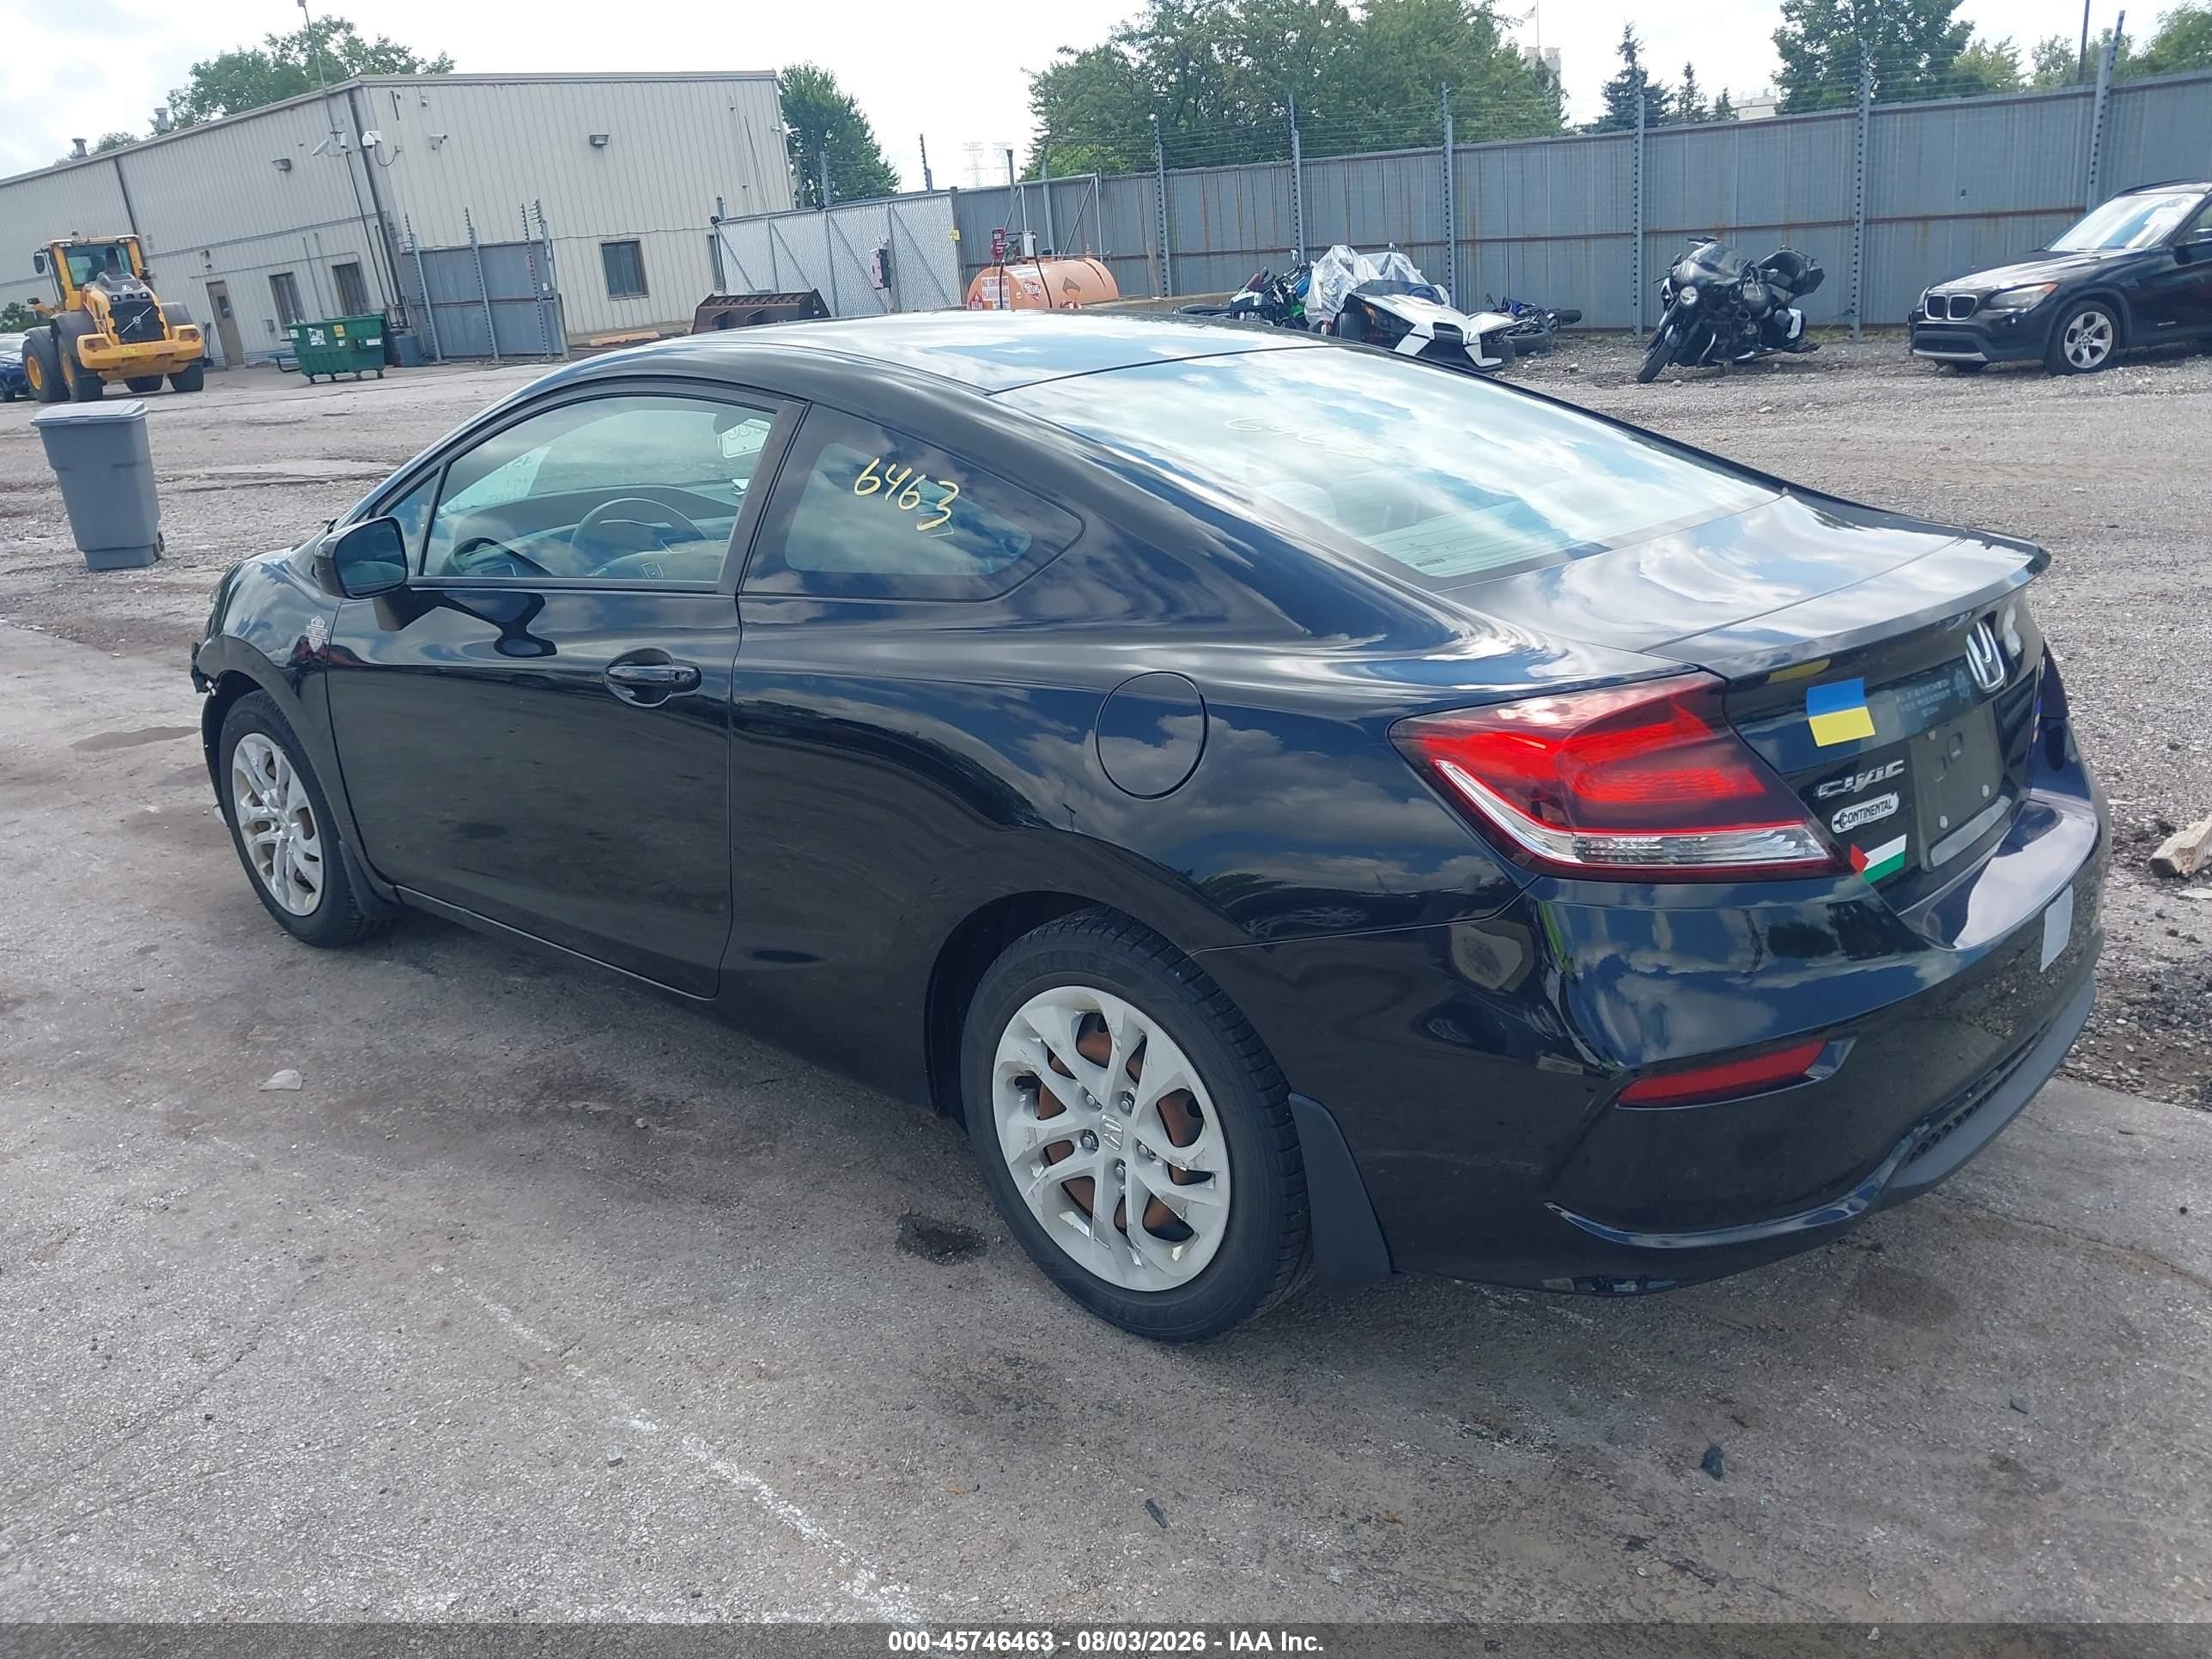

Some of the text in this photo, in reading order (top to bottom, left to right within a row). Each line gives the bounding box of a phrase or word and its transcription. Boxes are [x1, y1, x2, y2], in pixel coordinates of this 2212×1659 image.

[982, 276, 1009, 288] NO SMONG
[854, 457, 960, 532] 6463
[1816, 760, 1905, 798] CIVIC
[1836, 798, 1894, 830] CONTINENTAL
